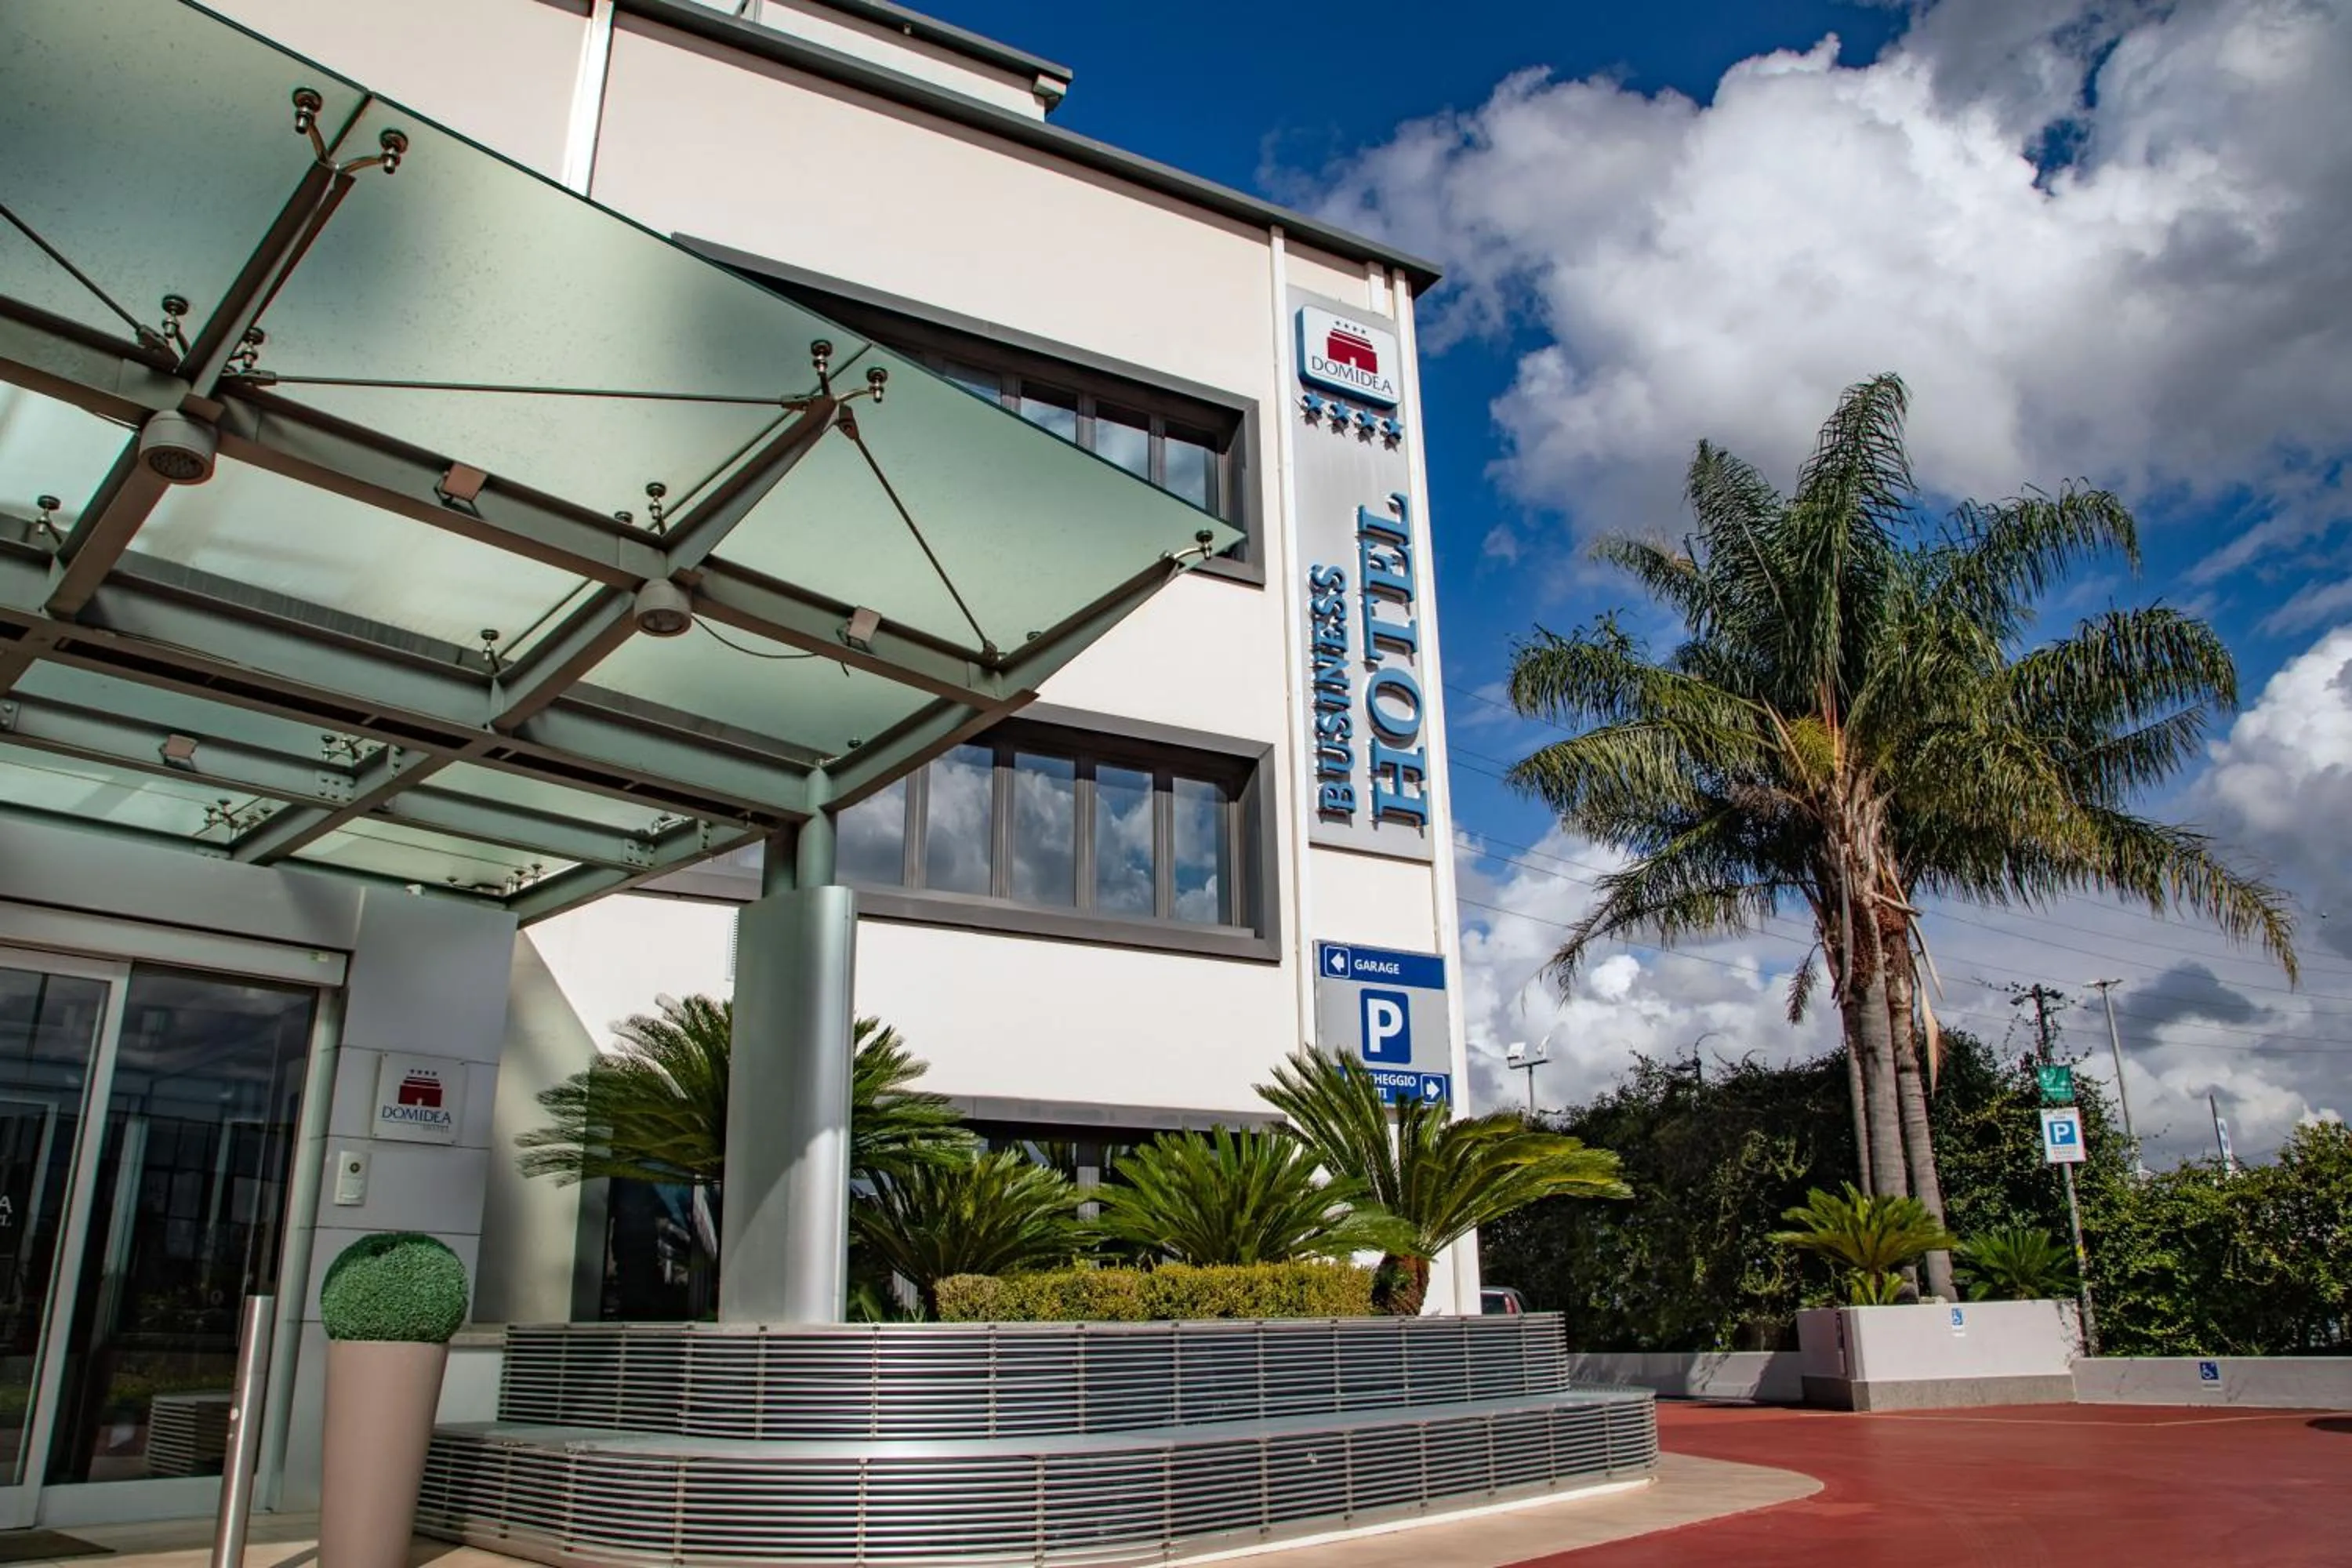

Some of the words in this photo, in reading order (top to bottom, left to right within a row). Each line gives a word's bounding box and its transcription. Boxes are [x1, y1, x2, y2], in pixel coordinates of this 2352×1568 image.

[1312, 355, 1393, 394] DOMIDEA
[1358, 492, 1428, 826] HOTEL
[1310, 564, 1356, 814] BUSINESS
[1354, 958, 1400, 975] GARAGE
[1367, 998, 1403, 1053] P
[381, 1105, 452, 1123] DOMIDEA
[2053, 1123, 2070, 1142] P
